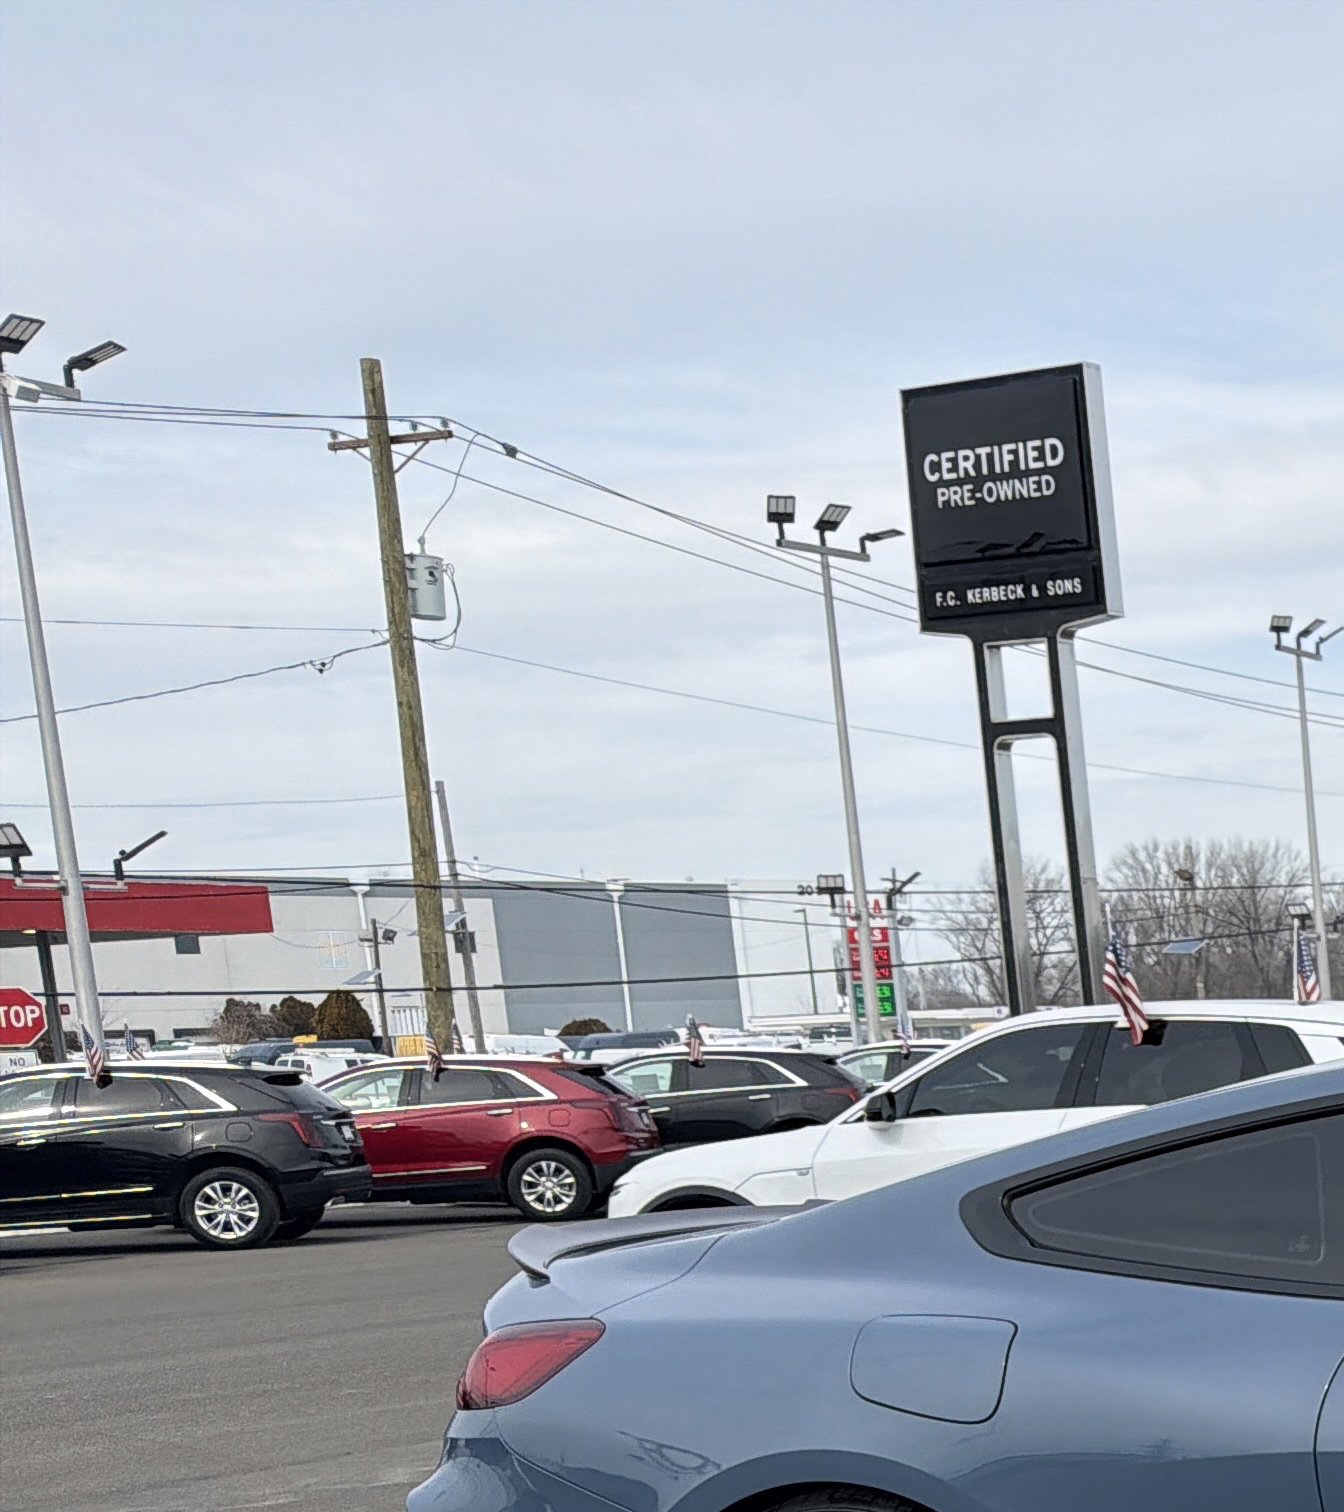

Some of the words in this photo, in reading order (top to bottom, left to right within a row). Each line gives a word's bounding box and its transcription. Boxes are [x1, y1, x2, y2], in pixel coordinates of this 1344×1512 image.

[923, 437, 1065, 482] CERTIFIED
[936, 474, 1056, 508] PRE-OWNED
[935, 591, 961, 607] F.C.
[966, 583, 1026, 604] KERBECK
[1031, 583, 1039, 597] &
[1046, 578, 1082, 596] SONS
[0, 1005, 41, 1028] TOP
[8, 1057, 26, 1067] NO
